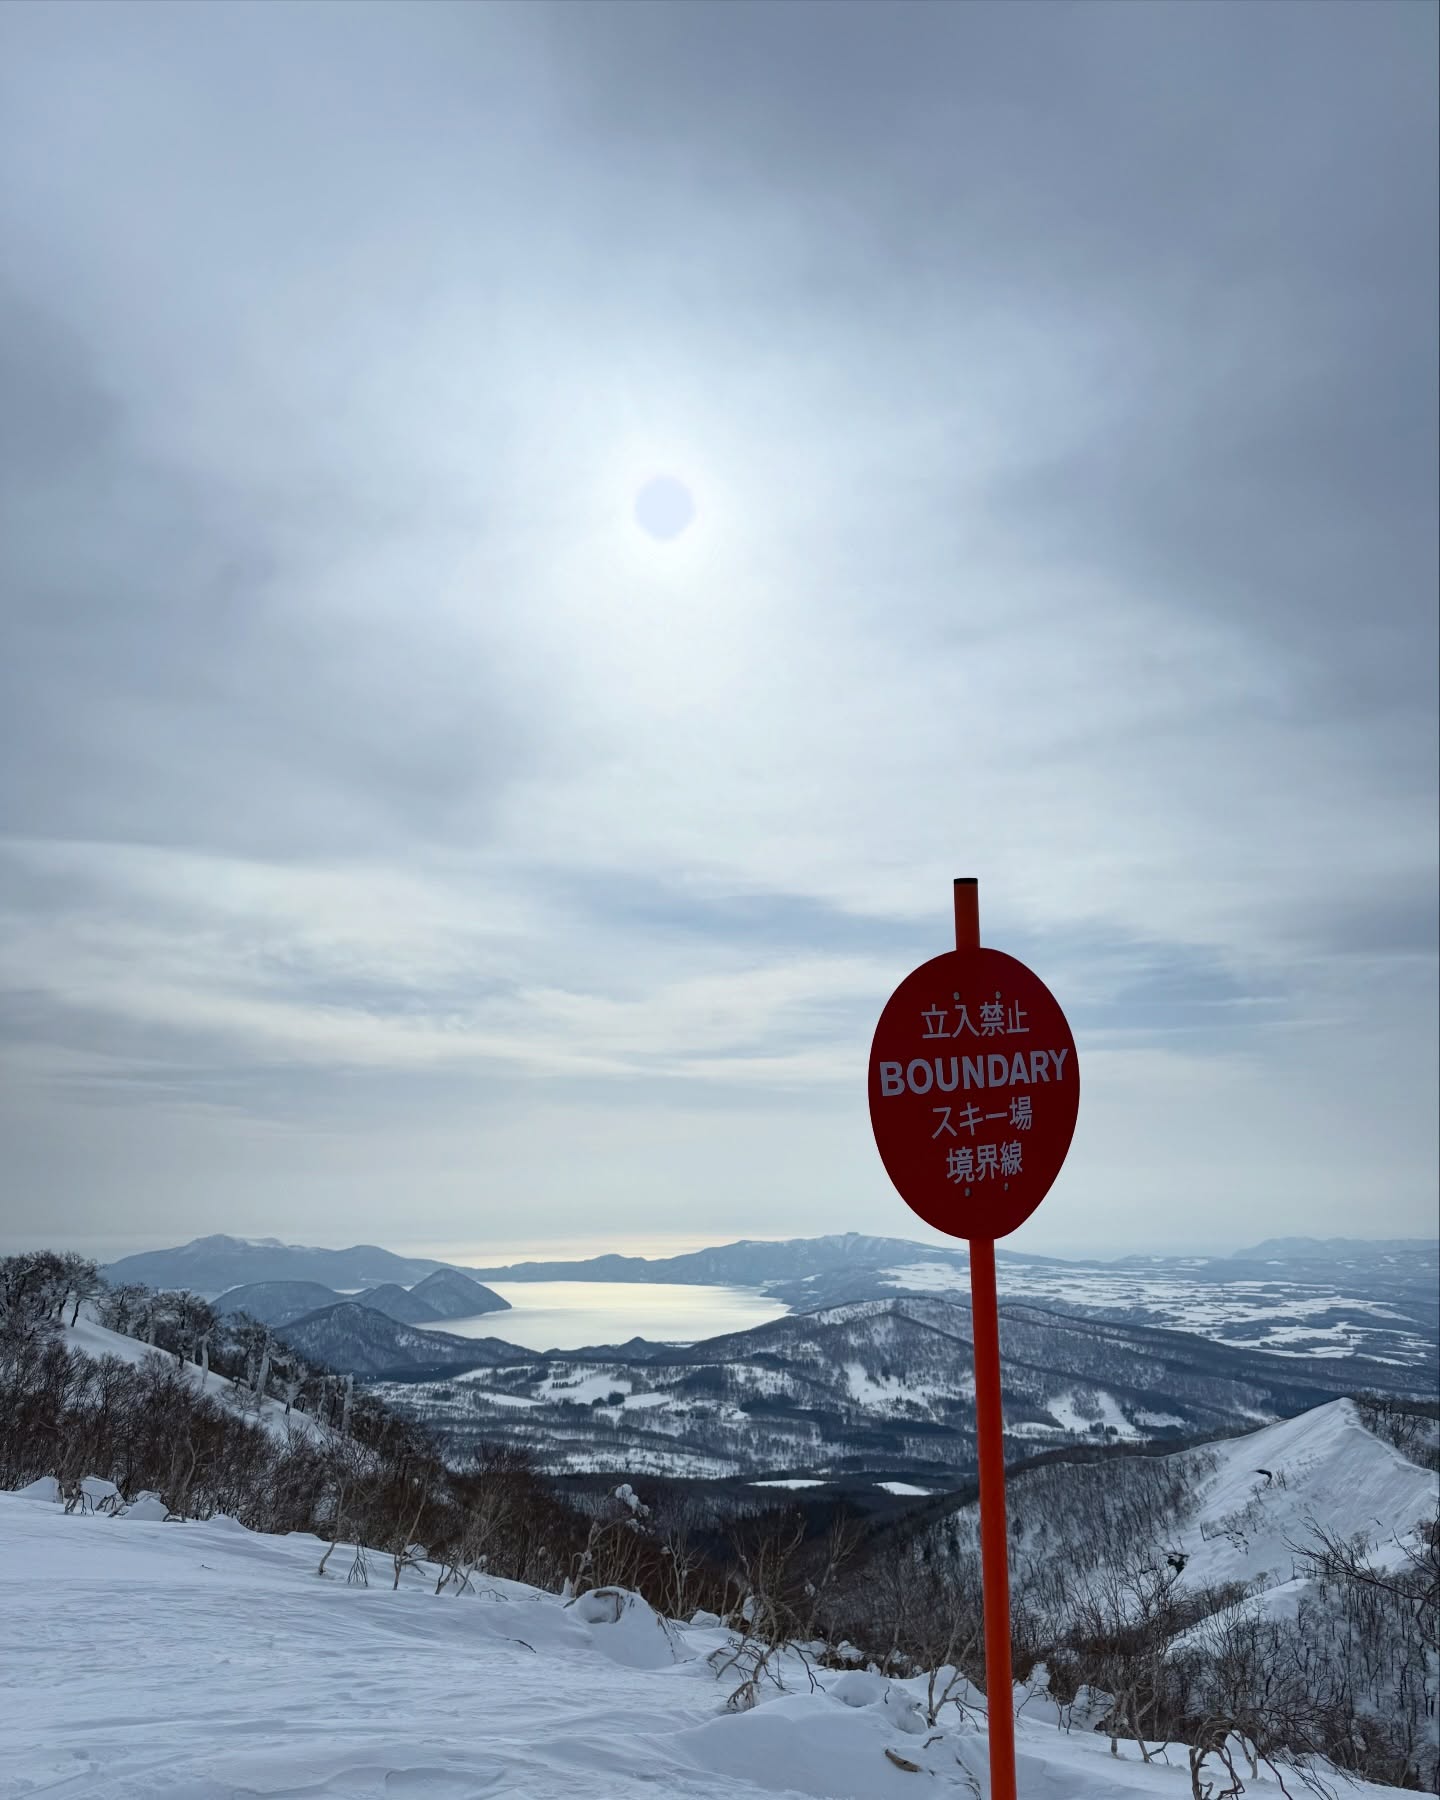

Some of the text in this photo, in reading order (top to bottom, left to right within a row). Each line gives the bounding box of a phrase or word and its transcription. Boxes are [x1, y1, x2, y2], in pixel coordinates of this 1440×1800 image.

[921, 1000, 1030, 1039] 立入禁止
[880, 1049, 1069, 1097] BOUNDARY
[932, 1096, 1033, 1139] スキー場
[946, 1140, 1023, 1184] 境界線
